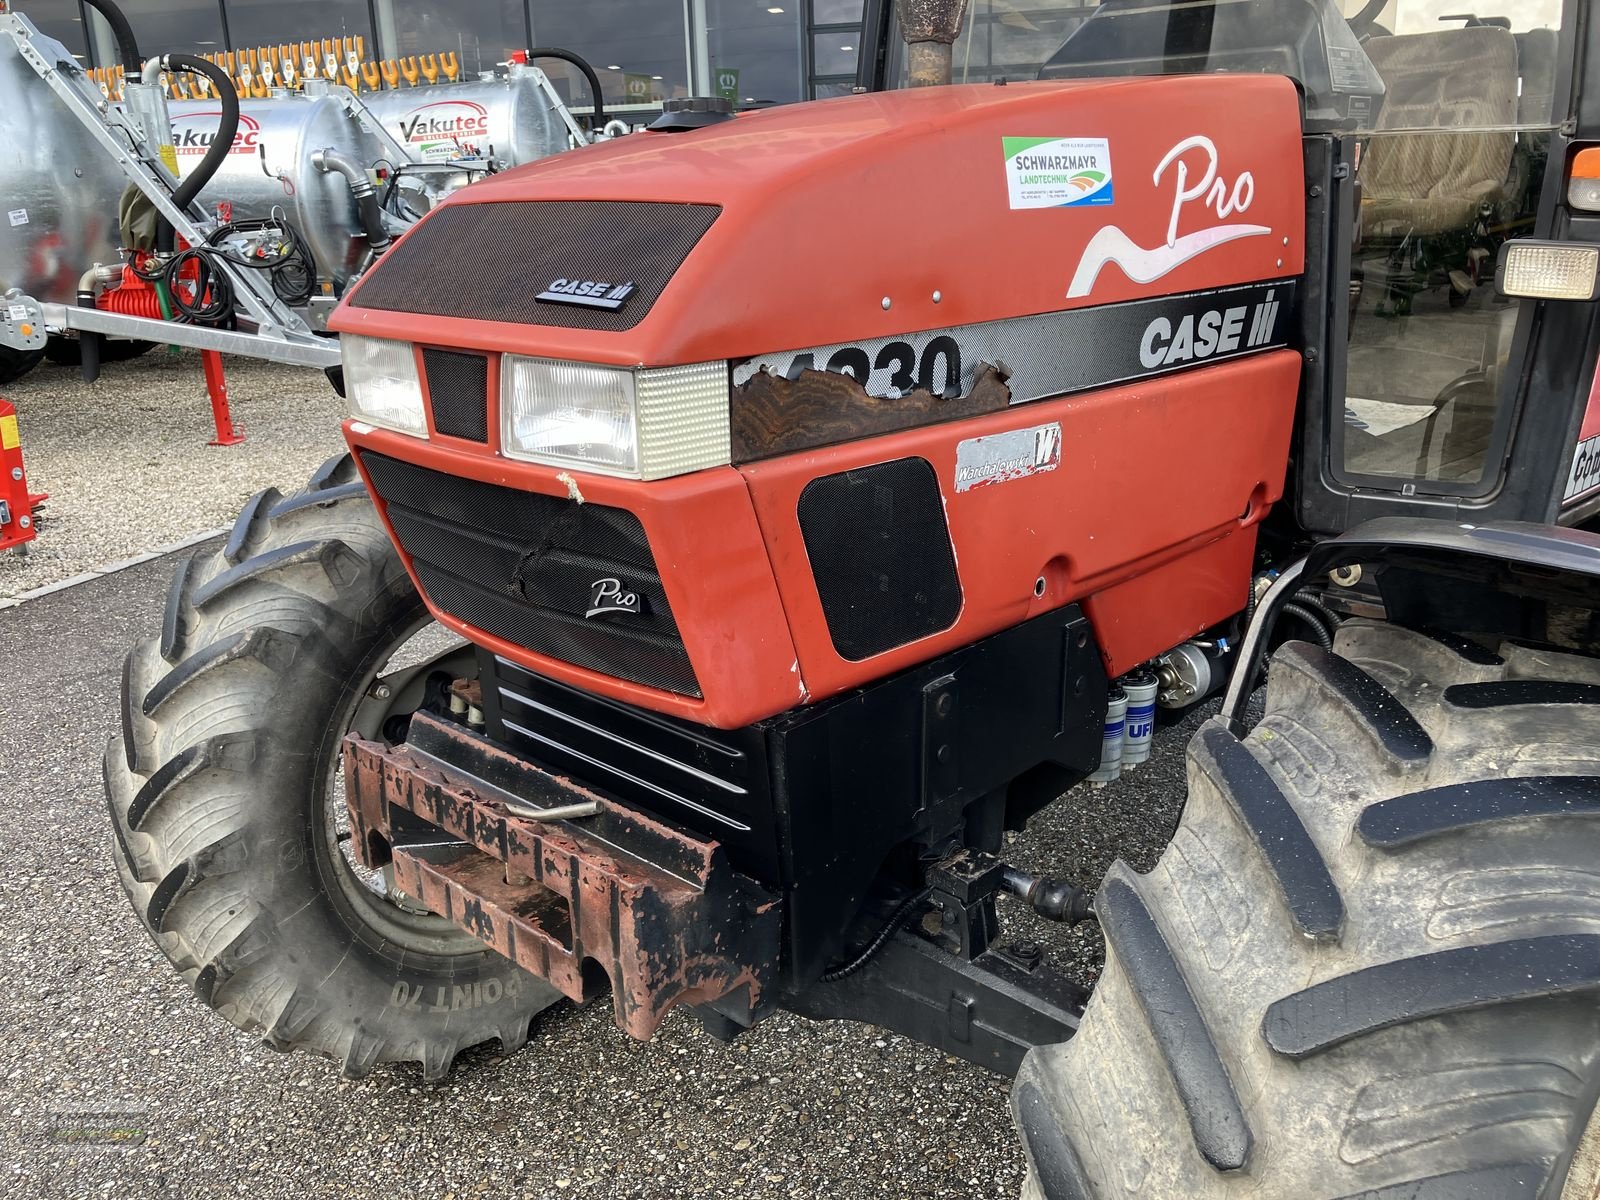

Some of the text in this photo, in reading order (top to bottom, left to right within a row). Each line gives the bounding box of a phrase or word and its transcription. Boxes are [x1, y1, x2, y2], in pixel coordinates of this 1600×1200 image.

[170, 123, 259, 147] akuec
[399, 114, 488, 142] Vakutec
[1015, 155, 1097, 171] SCHWARZMAYR
[1019, 174, 1069, 185] LANDTECHNIK
[1153, 135, 1254, 248] Pro
[547, 278, 611, 297] CASE
[1139, 305, 1248, 369] CASE
[957, 450, 1031, 483] Warchalowski
[591, 577, 636, 607] Pro
[1128, 721, 1154, 739] UFI
[389, 968, 524, 1013] POINT 70
